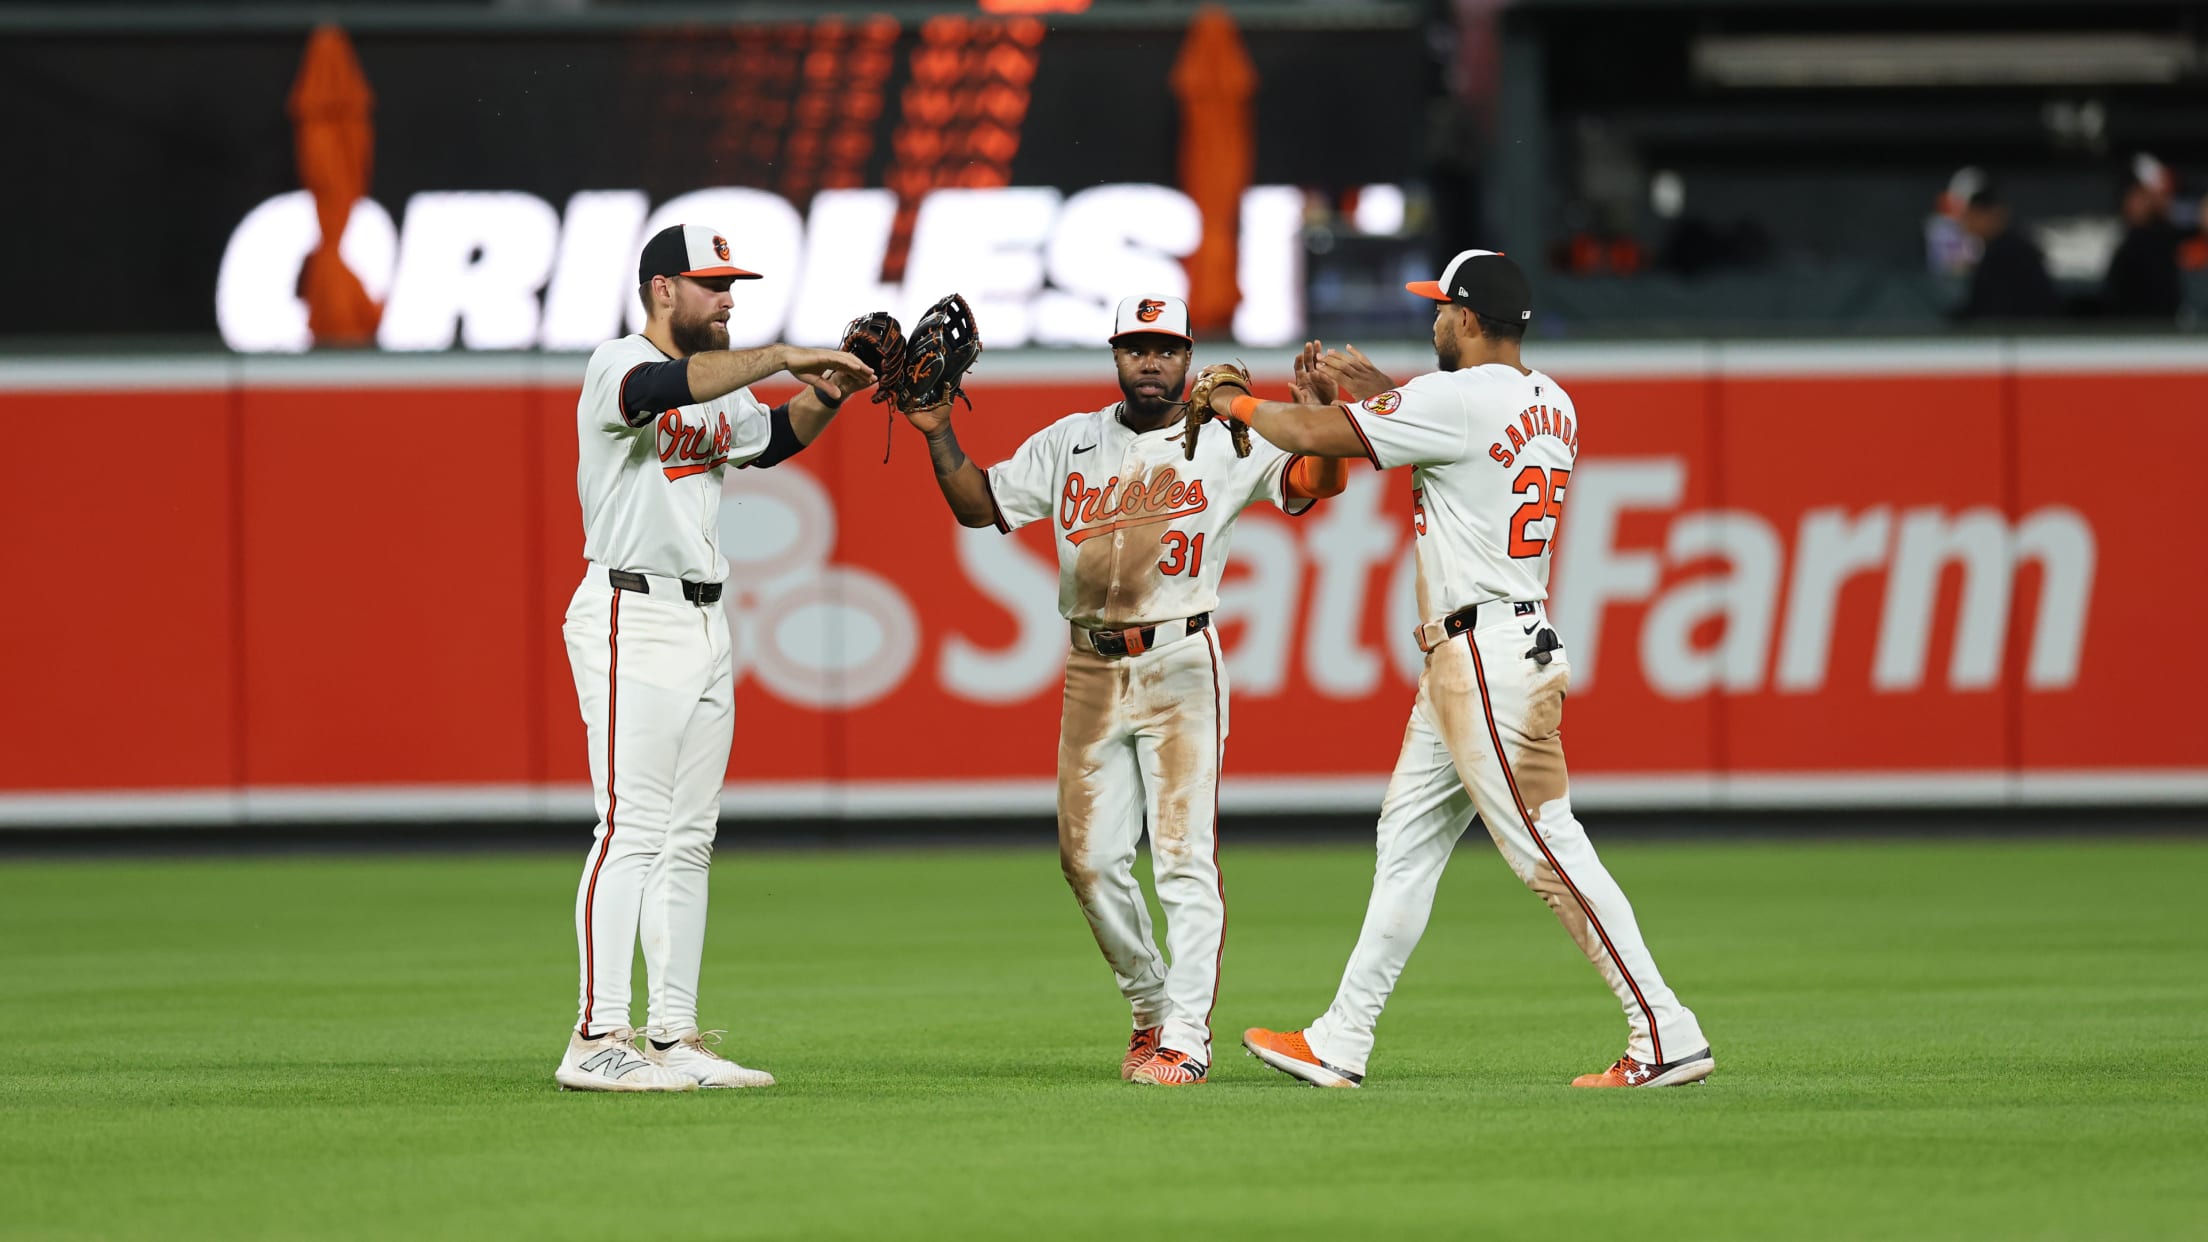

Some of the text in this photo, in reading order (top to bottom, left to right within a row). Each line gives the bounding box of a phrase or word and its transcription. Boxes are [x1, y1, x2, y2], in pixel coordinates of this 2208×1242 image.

[217, 184, 1203, 351] ORIOLES
[1489, 405, 1577, 468] SANTAND
[1060, 468, 1208, 530] Orioles
[1508, 465, 1571, 559] 25
[1158, 530, 1205, 577] 31
[1552, 456, 2094, 697] Farm
[1128, 637, 1140, 650] 31
